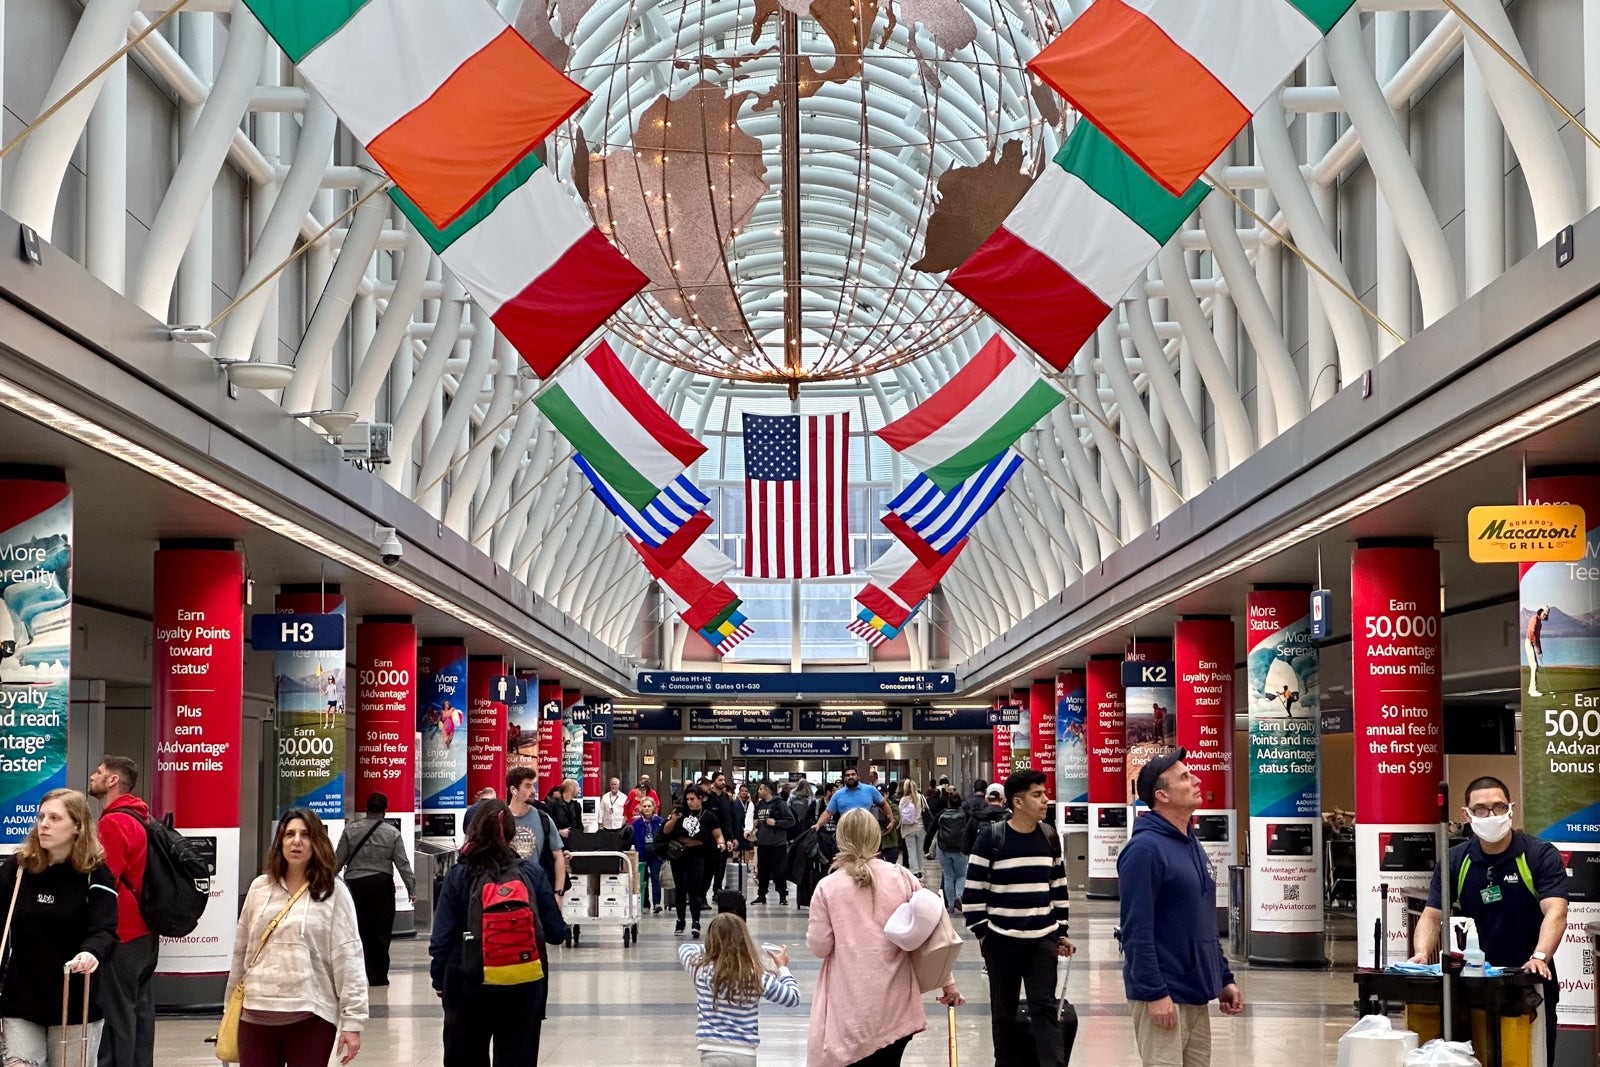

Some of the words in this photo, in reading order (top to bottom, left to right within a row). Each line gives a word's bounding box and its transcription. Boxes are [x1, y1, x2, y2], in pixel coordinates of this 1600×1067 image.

[1478, 519, 1578, 540] Macaroni
[1509, 520, 1554, 528] ROMANO'S
[1510, 542, 1554, 550] GRILL
[1566, 562, 1600, 580] Tee
[0, 566, 56, 589] renity
[1390, 599, 1416, 611] Earn
[177, 609, 205, 620] Earn
[1250, 606, 1276, 617] More
[1250, 619, 1282, 630] Status.
[1365, 616, 1436, 640] 50,000
[157, 627, 192, 642] Loyalty
[196, 627, 231, 640] Points
[281, 622, 314, 643] H3
[1284, 632, 1312, 642] More
[169, 644, 213, 656] toward
[1276, 644, 1318, 660] Serenity
[1127, 652, 1146, 660] More
[374, 659, 393, 668] Earn
[1198, 660, 1218, 669] Earn
[1370, 663, 1406, 675] bonus
[1409, 663, 1436, 675] miles
[360, 670, 409, 687] 50,000
[435, 674, 458, 684] More
[1142, 666, 1167, 682] K2
[1182, 673, 1210, 683] Loyalty
[1212, 672, 1232, 681] Points
[438, 684, 456, 694] Play.
[1194, 685, 1222, 693] toward
[0, 687, 48, 708] oyalty
[474, 699, 492, 707] Enjoy
[1574, 694, 1600, 707] Ear
[176, 705, 202, 718] Plus
[362, 702, 384, 711] bonus
[386, 702, 406, 711] miles
[1098, 702, 1112, 710] your
[1381, 704, 1398, 718] $0
[1402, 705, 1428, 718] intro
[20, 709, 59, 726] reach
[469, 708, 498, 716] preferred
[174, 725, 202, 736] earn
[594, 725, 604, 736] G
[1200, 726, 1218, 734] Plus
[1258, 721, 1280, 731] Earn
[1284, 720, 1316, 734] Loyalty
[1366, 723, 1406, 736] annual
[1408, 722, 1426, 736] fee
[1428, 722, 1439, 736] for
[1545, 710, 1600, 740] 50,0
[294, 728, 316, 736] Earn
[366, 731, 378, 740] $0
[379, 731, 399, 740] intro
[1252, 734, 1278, 745] Points
[1280, 736, 1300, 745] and
[280, 738, 334, 757] 50,000
[359, 744, 382, 752] annual
[383, 744, 396, 752] fee
[398, 744, 408, 752] for
[1092, 747, 1114, 755] Loyalty
[1130, 746, 1142, 754] Get
[1144, 746, 1164, 756] your
[1369, 740, 1388, 754] the
[1390, 740, 1414, 754] first
[1416, 742, 1438, 757] year,
[427, 750, 450, 760] Enjoy
[157, 758, 190, 772] bonus
[192, 758, 224, 772] miles
[371, 756, 388, 764] first
[388, 758, 407, 766] year,
[1186, 762, 1210, 771] bonus
[1212, 762, 1231, 771] miles
[1550, 758, 1594, 773] bonus
[280, 768, 306, 777] bonus
[308, 768, 330, 777] miles
[1260, 764, 1288, 773] status
[1378, 761, 1406, 774] then
[364, 770, 381, 778] then
[1566, 824, 1581, 832] THE
[1260, 903, 1317, 911] ApplyAviator.com
